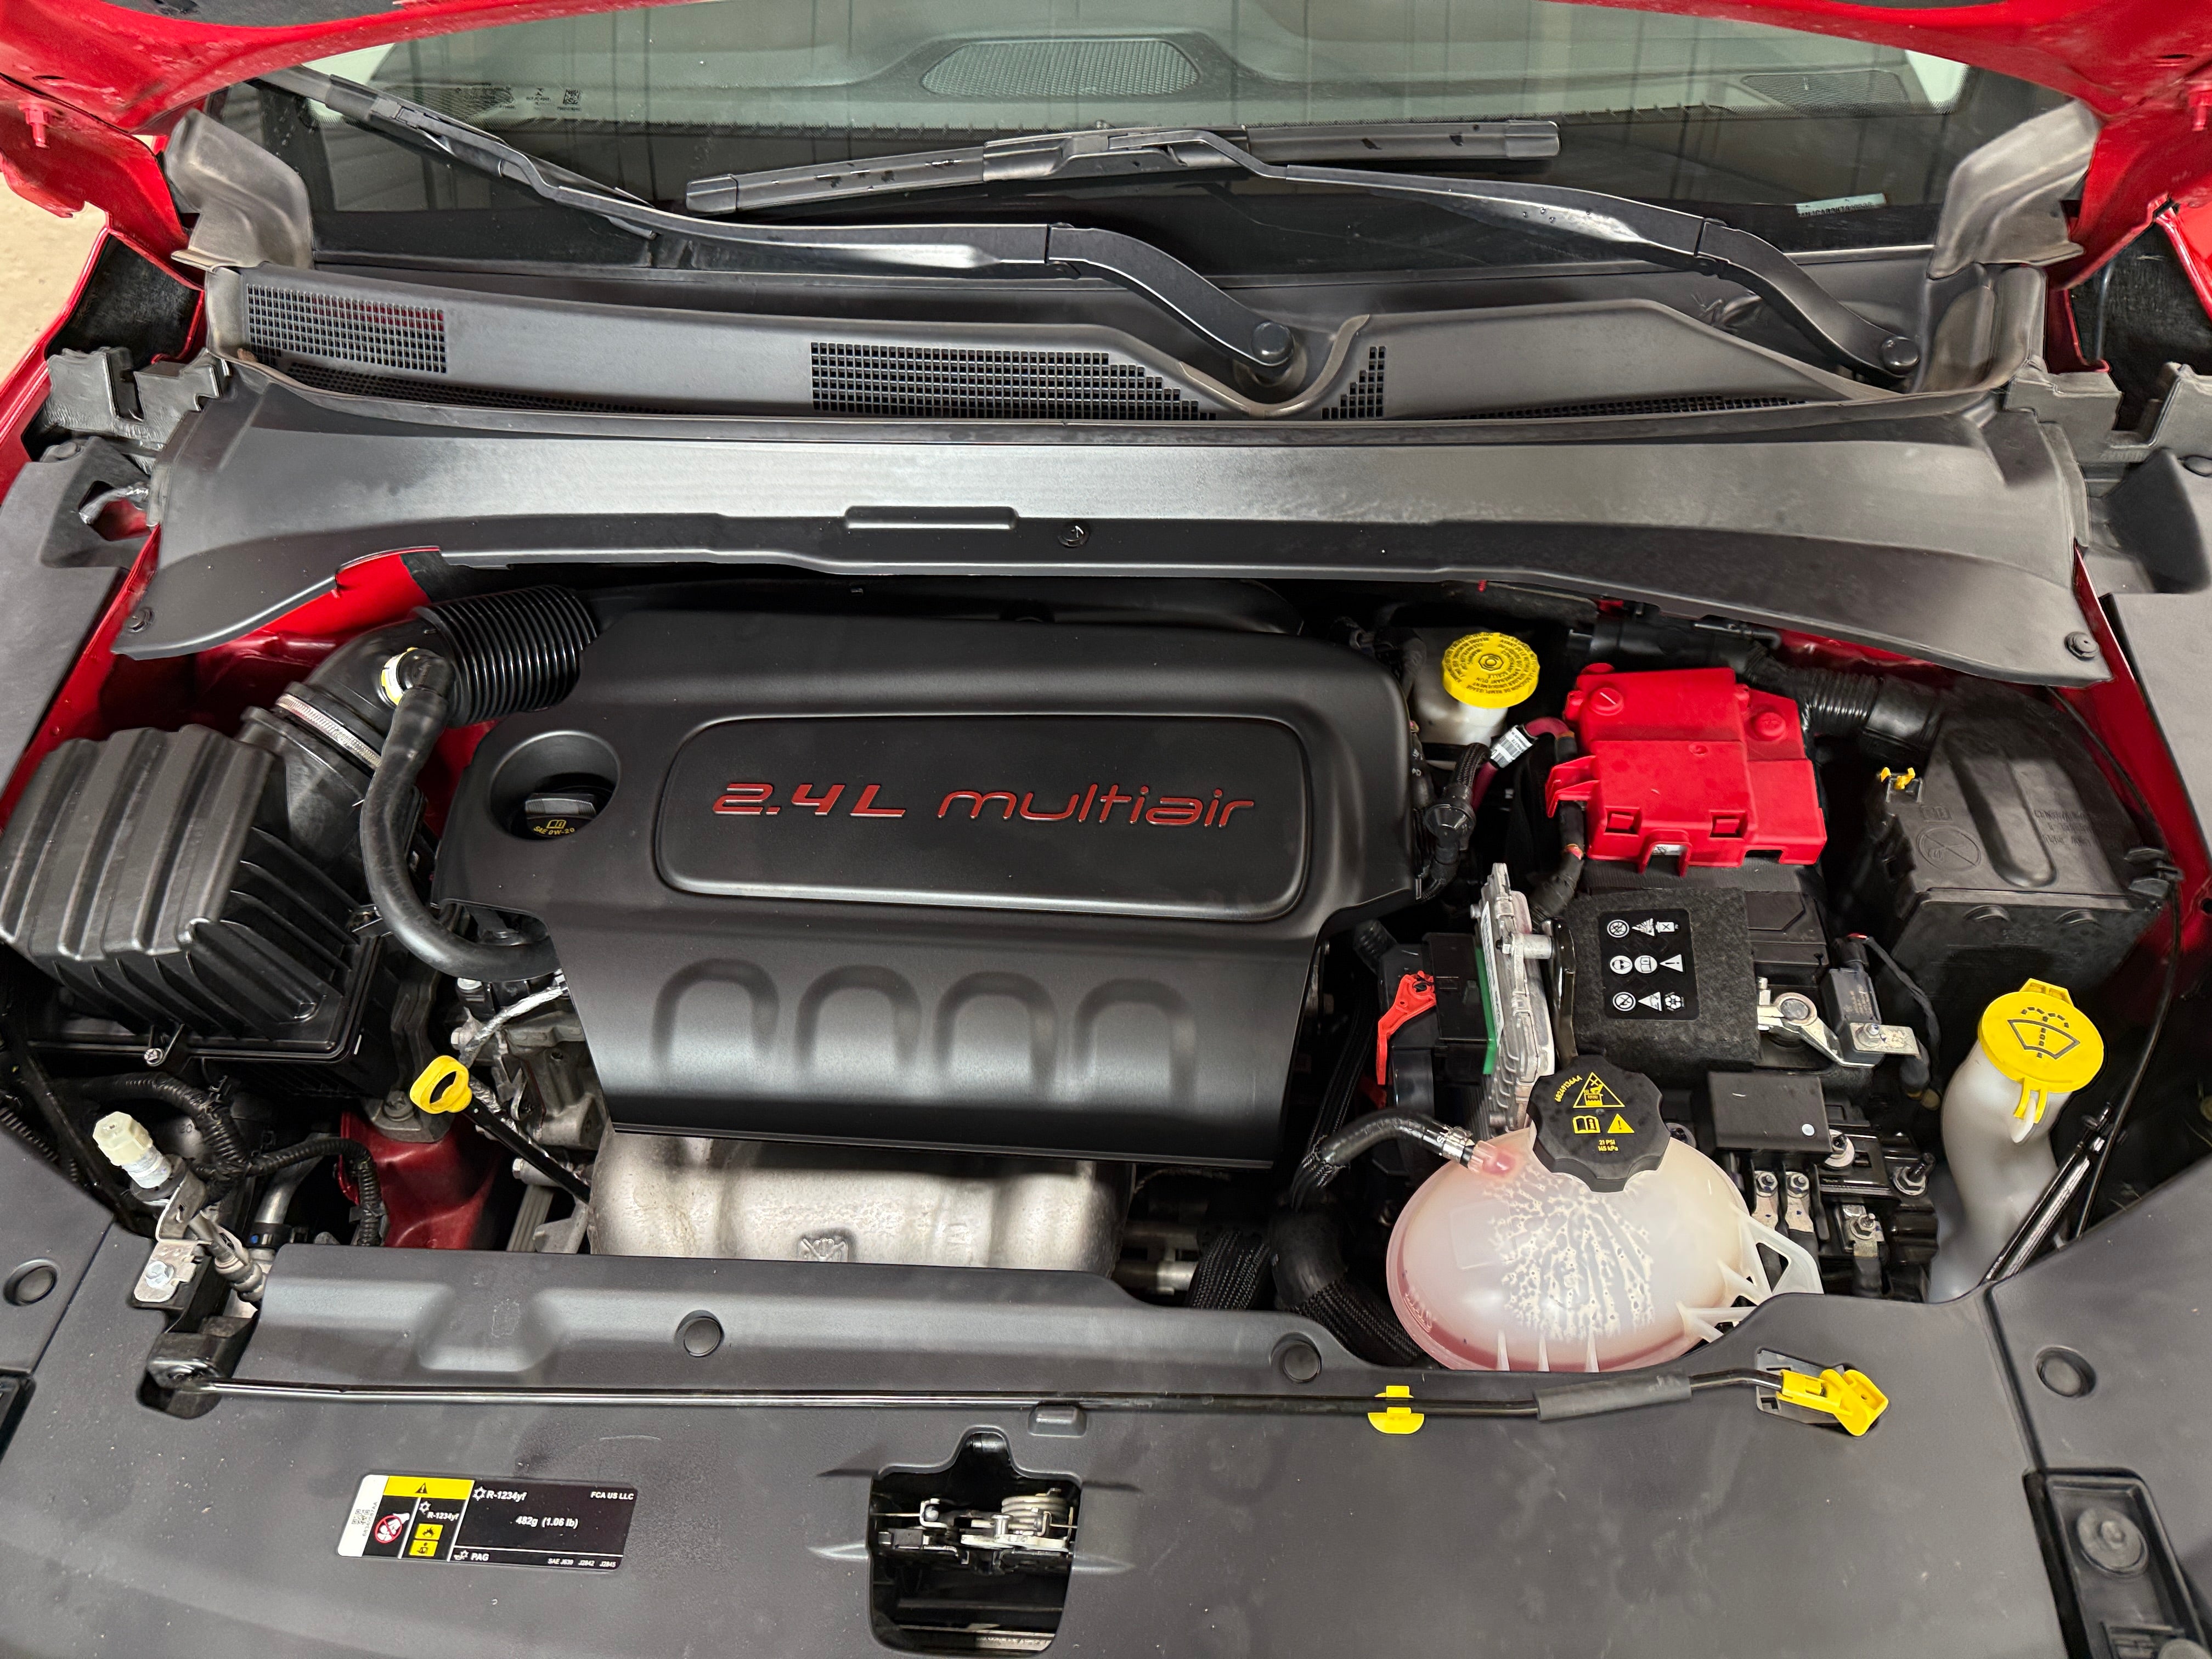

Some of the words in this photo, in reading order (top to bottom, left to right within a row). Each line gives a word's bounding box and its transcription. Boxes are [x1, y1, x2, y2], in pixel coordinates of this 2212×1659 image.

[937, 783, 1254, 828] multiair
[533, 826, 548, 834] SAE
[486, 1490, 528, 1503] R-1234yf
[427, 1511, 459, 1521] R-1234yf
[515, 1515, 539, 1528] 482g
[541, 1516, 565, 1528] (1.06
[565, 1518, 579, 1530] lb)
[471, 1553, 489, 1561] PAG
